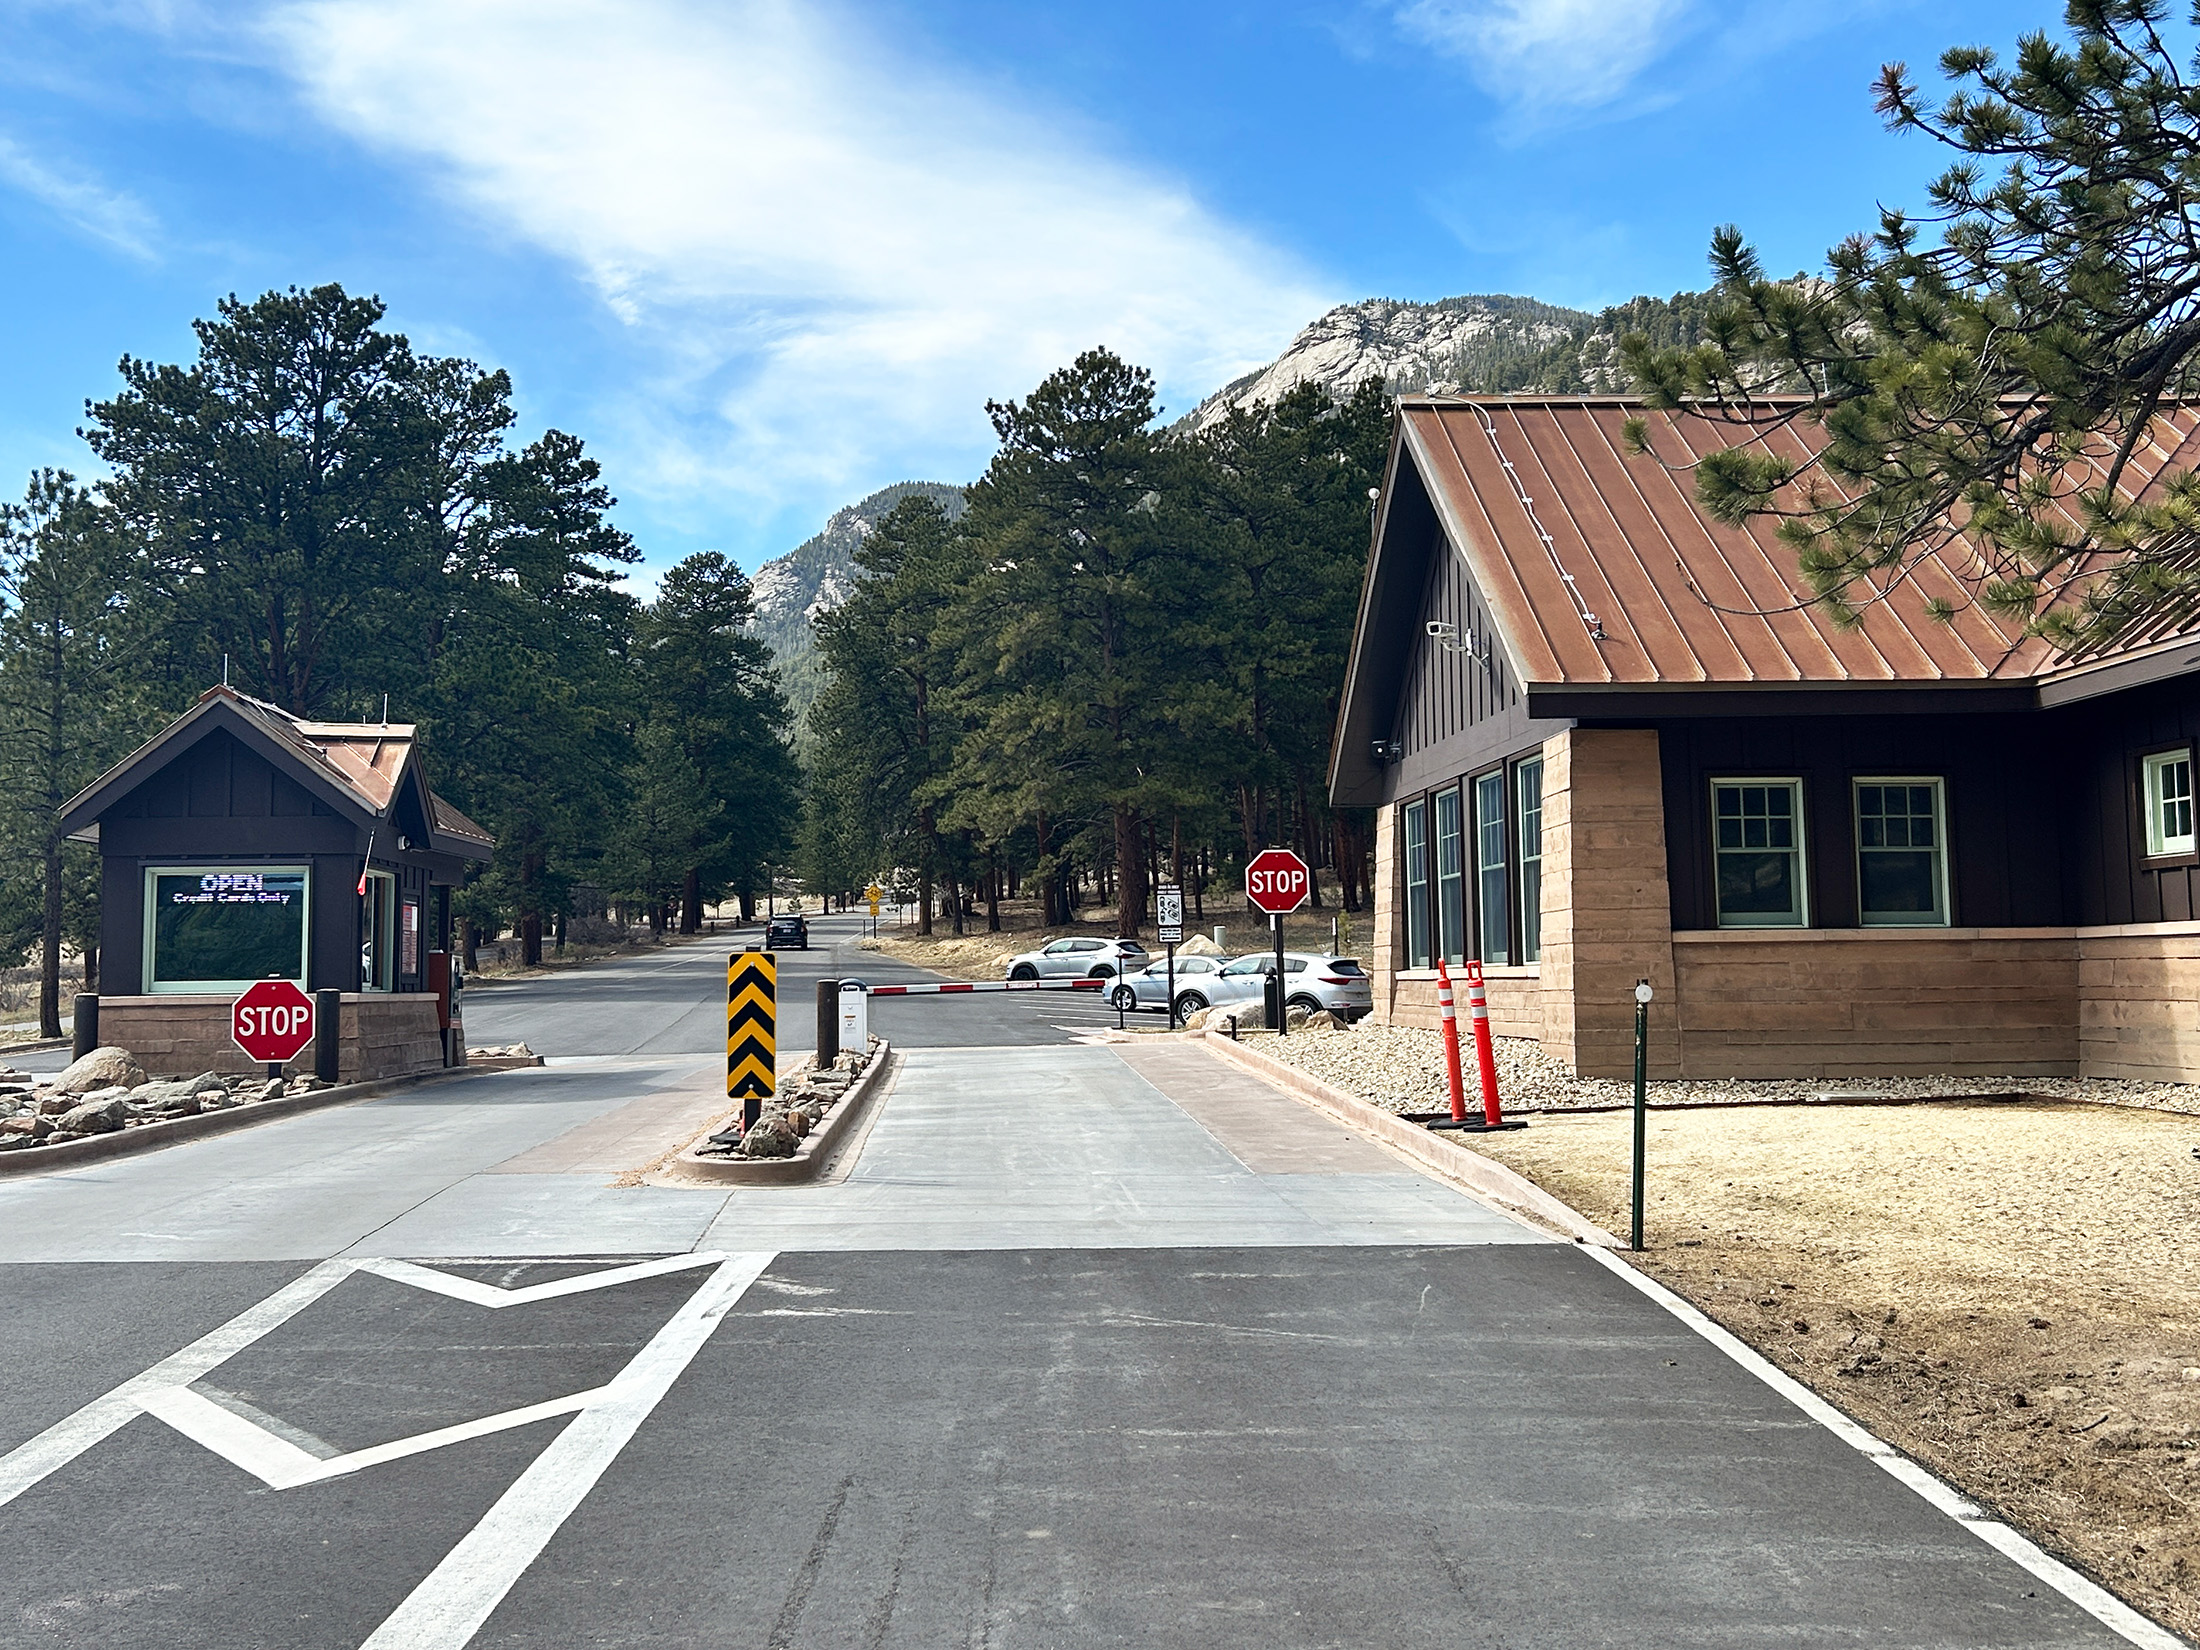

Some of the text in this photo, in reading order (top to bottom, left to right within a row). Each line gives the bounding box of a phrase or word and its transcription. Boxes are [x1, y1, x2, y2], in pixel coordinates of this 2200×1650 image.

[200, 874, 263, 891] OPEN
[1251, 870, 1304, 893] STOP
[173, 892, 289, 906] Credit Cards Only
[238, 1006, 309, 1036] STOP
